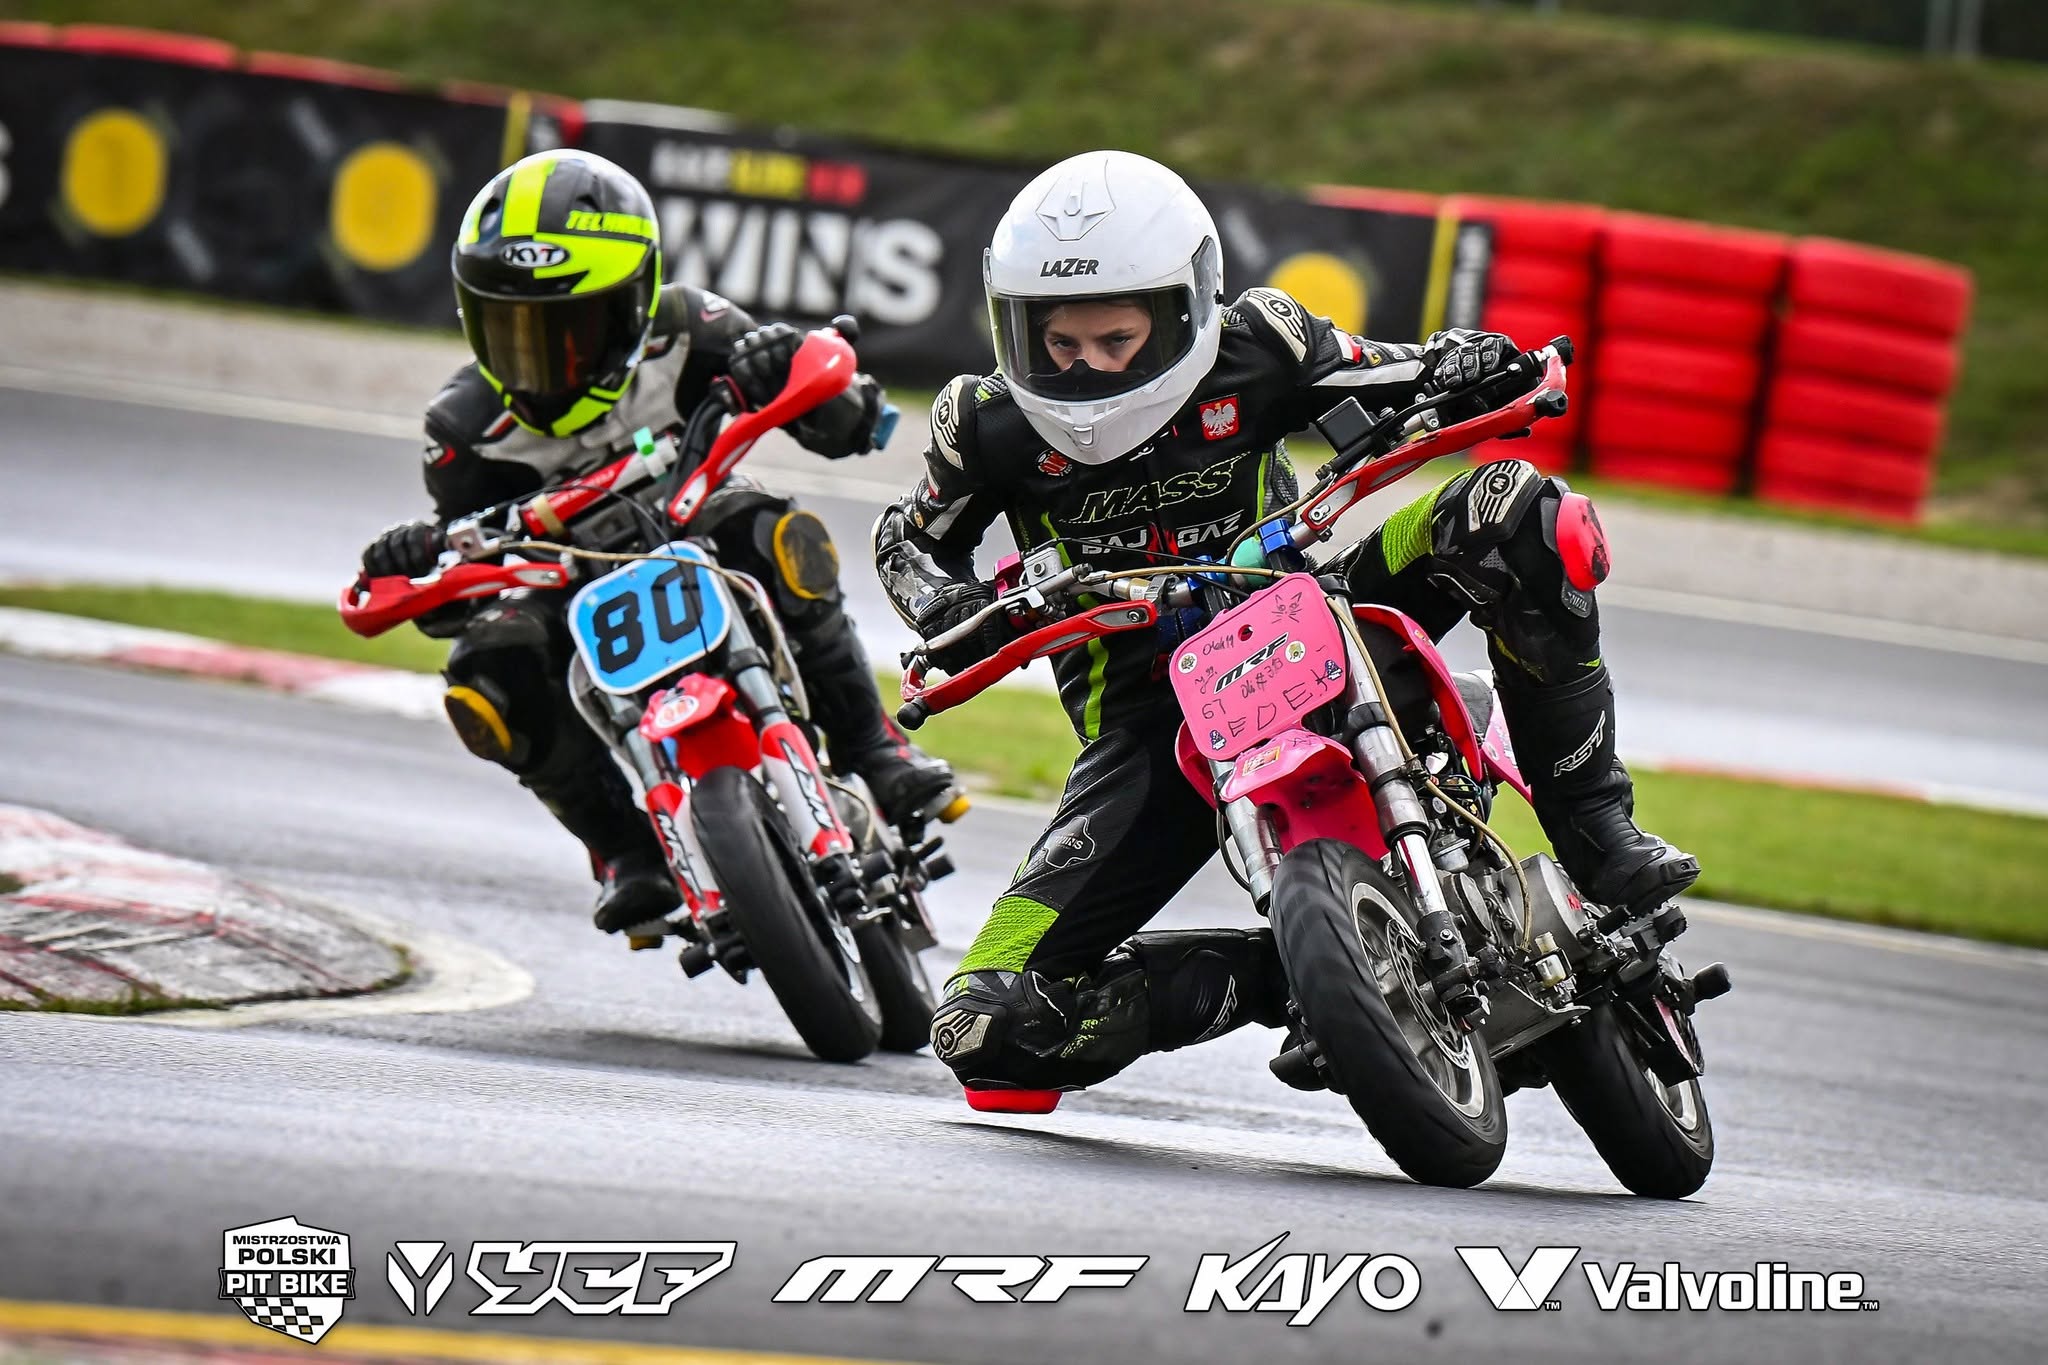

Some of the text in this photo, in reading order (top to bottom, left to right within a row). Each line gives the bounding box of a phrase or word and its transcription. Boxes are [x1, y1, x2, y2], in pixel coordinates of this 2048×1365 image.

[503, 247, 561, 262] KYT
[1040, 258, 1099, 277] LAZER
[1059, 451, 1250, 523] MASS
[1177, 513, 1242, 548] GAZ
[593, 566, 704, 674] 80
[1216, 633, 1288, 692] MRF
[1554, 710, 1606, 778] RST
